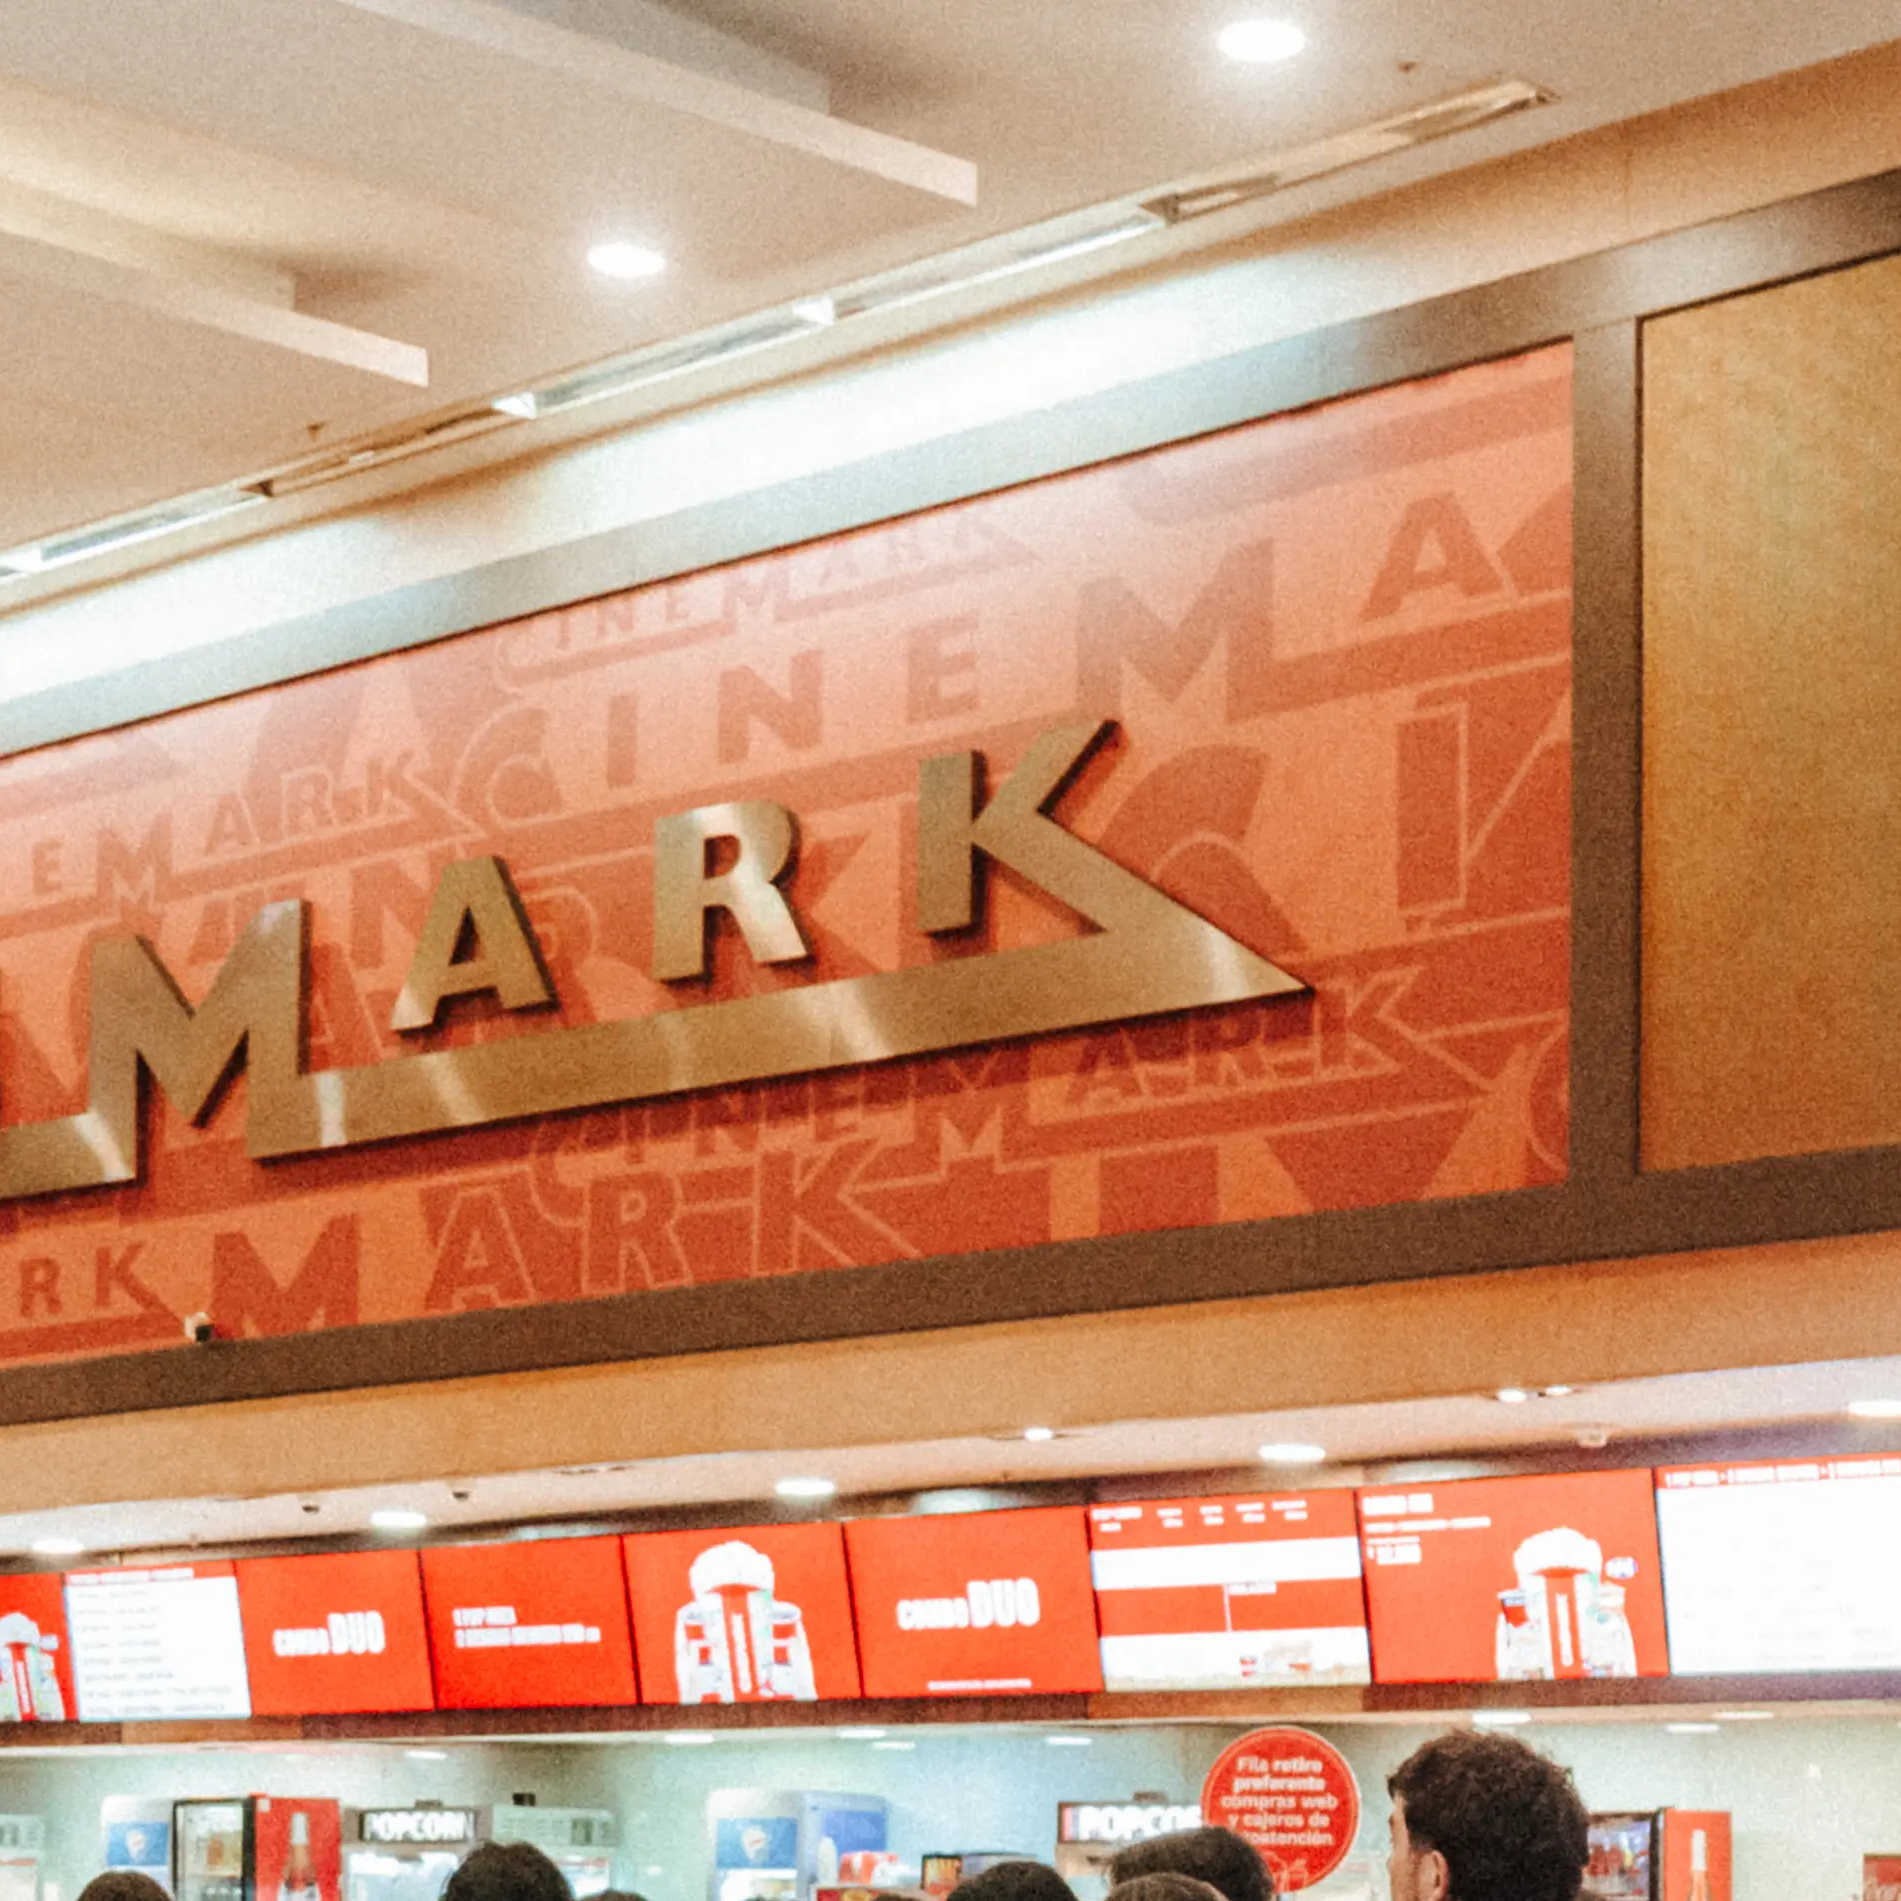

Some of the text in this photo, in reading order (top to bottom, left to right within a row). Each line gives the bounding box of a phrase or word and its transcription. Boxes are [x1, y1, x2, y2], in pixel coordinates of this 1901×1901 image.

[967, 1578, 1040, 1627] DUO
[1237, 1755, 1323, 1773] Fila retiro
[1232, 1774, 1326, 1794] preferente
[1220, 1792, 1339, 1811] compras web
[1227, 1811, 1331, 1831] y cajeros de
